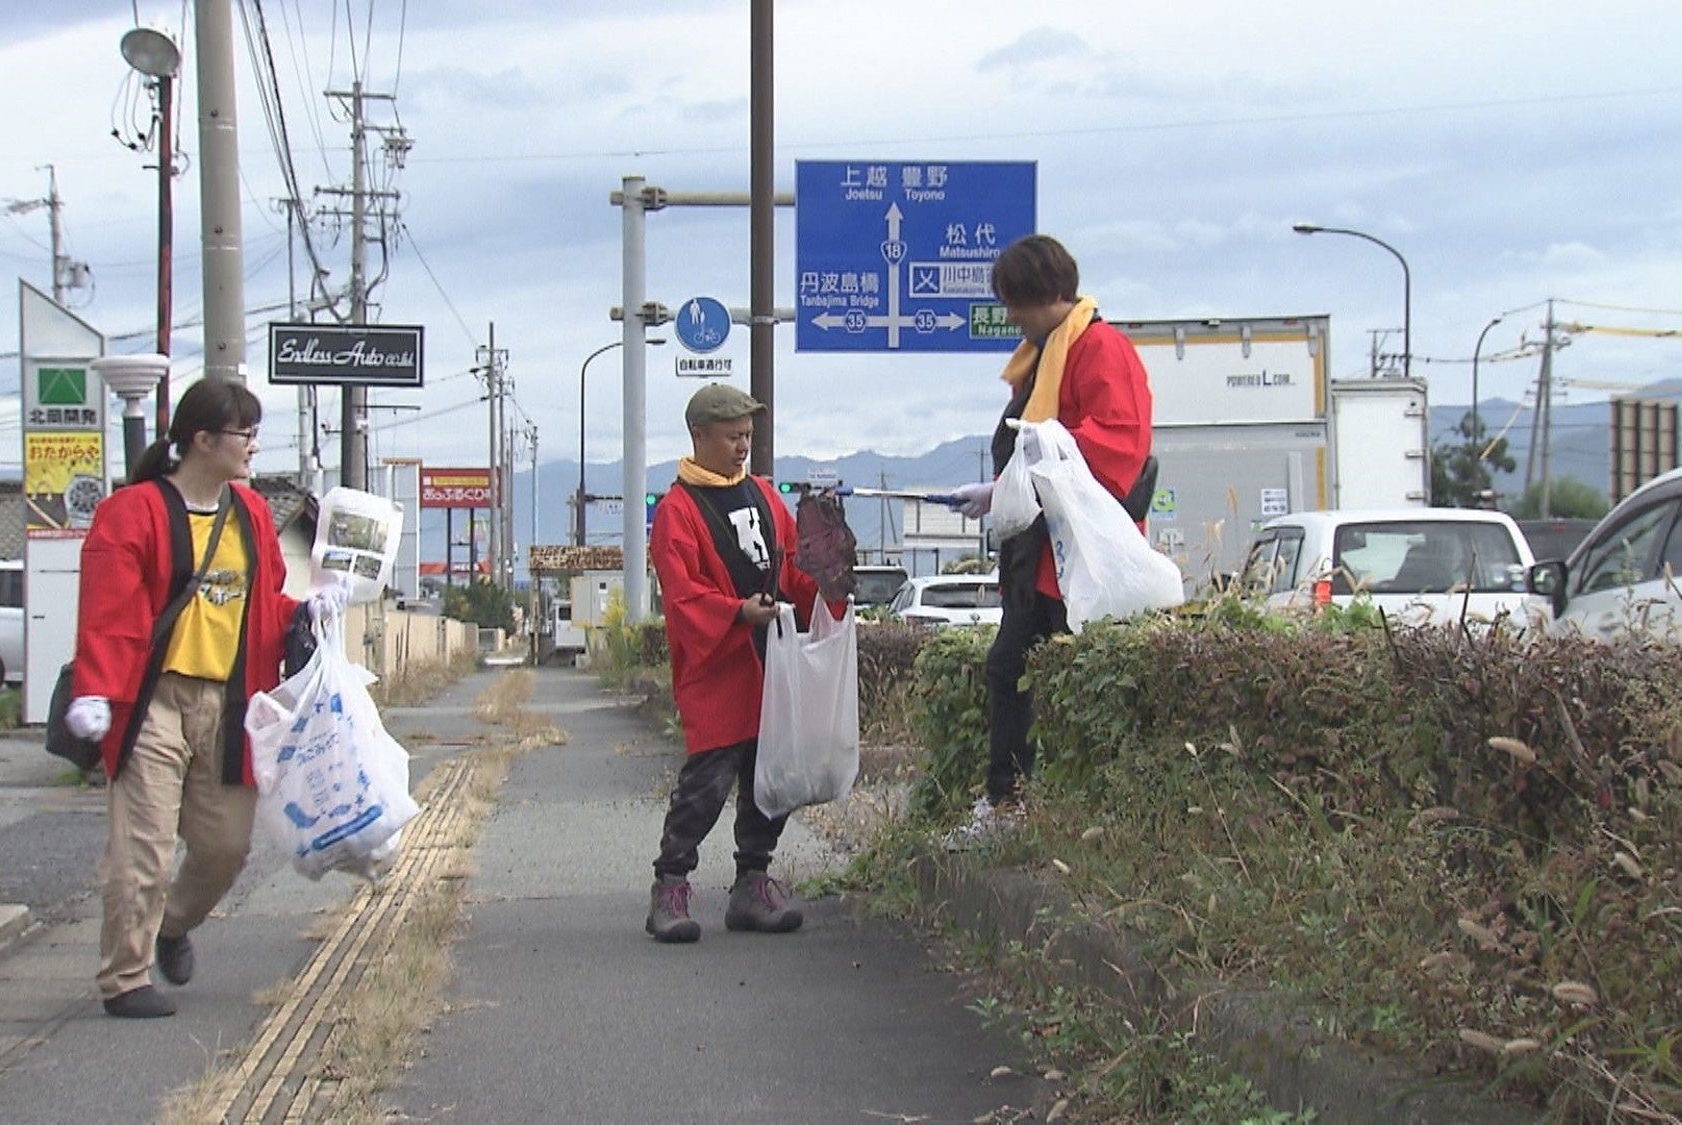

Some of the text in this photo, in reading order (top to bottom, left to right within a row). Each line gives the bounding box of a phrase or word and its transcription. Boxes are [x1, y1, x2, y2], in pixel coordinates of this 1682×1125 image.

[840, 165, 887, 187] 上越
[846, 188, 946, 202] Joetsu Toyono
[946, 223, 996, 245] 松代
[885, 244, 901, 258] 18
[800, 272, 880, 293] 丹波島橋
[800, 295, 880, 308] Tanbajima Bridge
[847, 314, 864, 328] 35
[917, 314, 934, 328] 35
[277, 338, 331, 364] Endless
[333, 340, 384, 367] Auto
